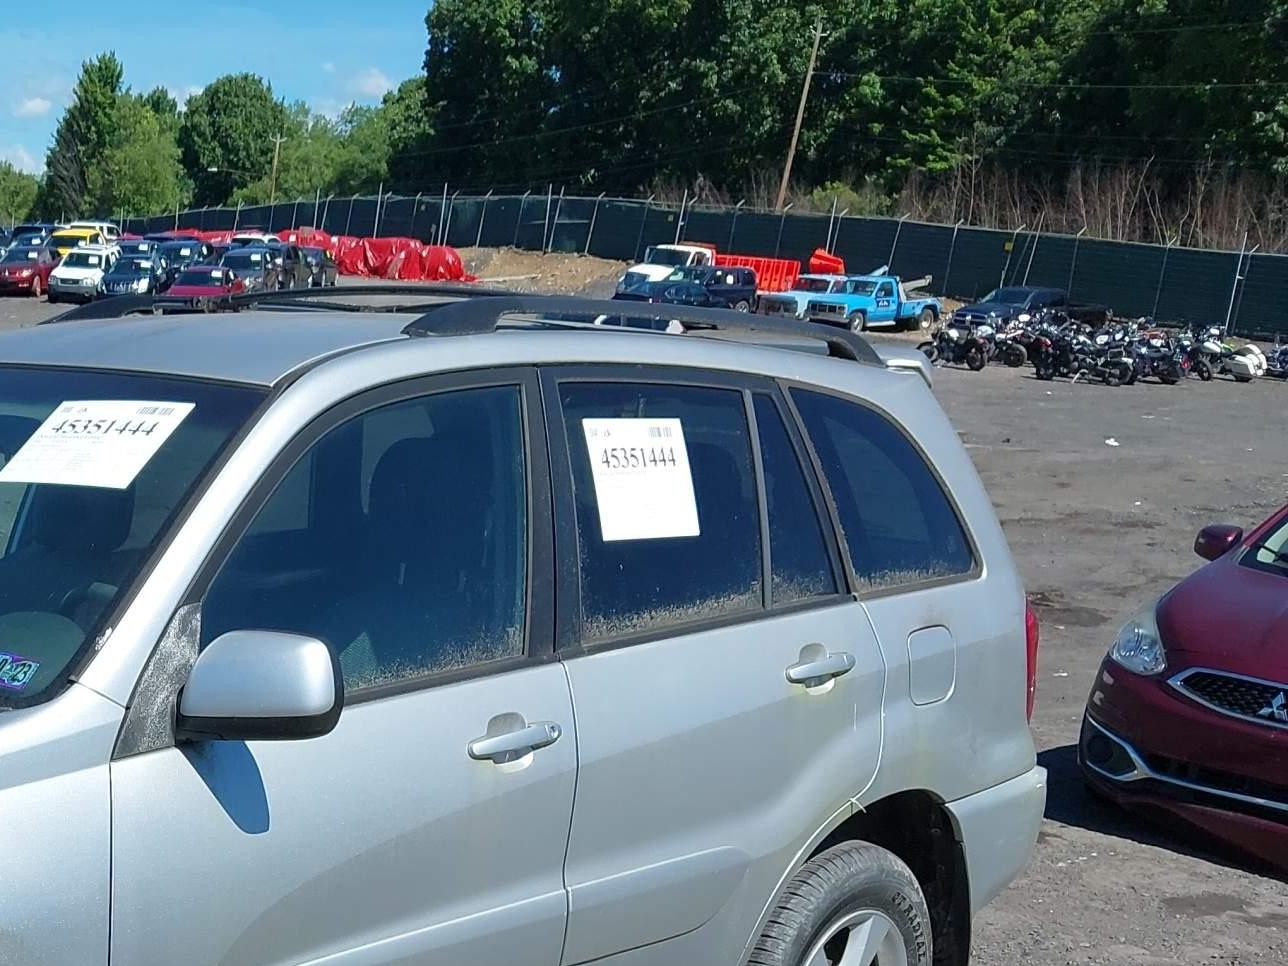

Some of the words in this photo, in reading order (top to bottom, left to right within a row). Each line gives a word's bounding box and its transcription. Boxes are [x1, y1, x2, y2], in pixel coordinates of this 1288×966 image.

[52, 418, 160, 437] 45351444
[601, 447, 677, 469] 45351444
[903, 903, 926, 963] RADIAL
